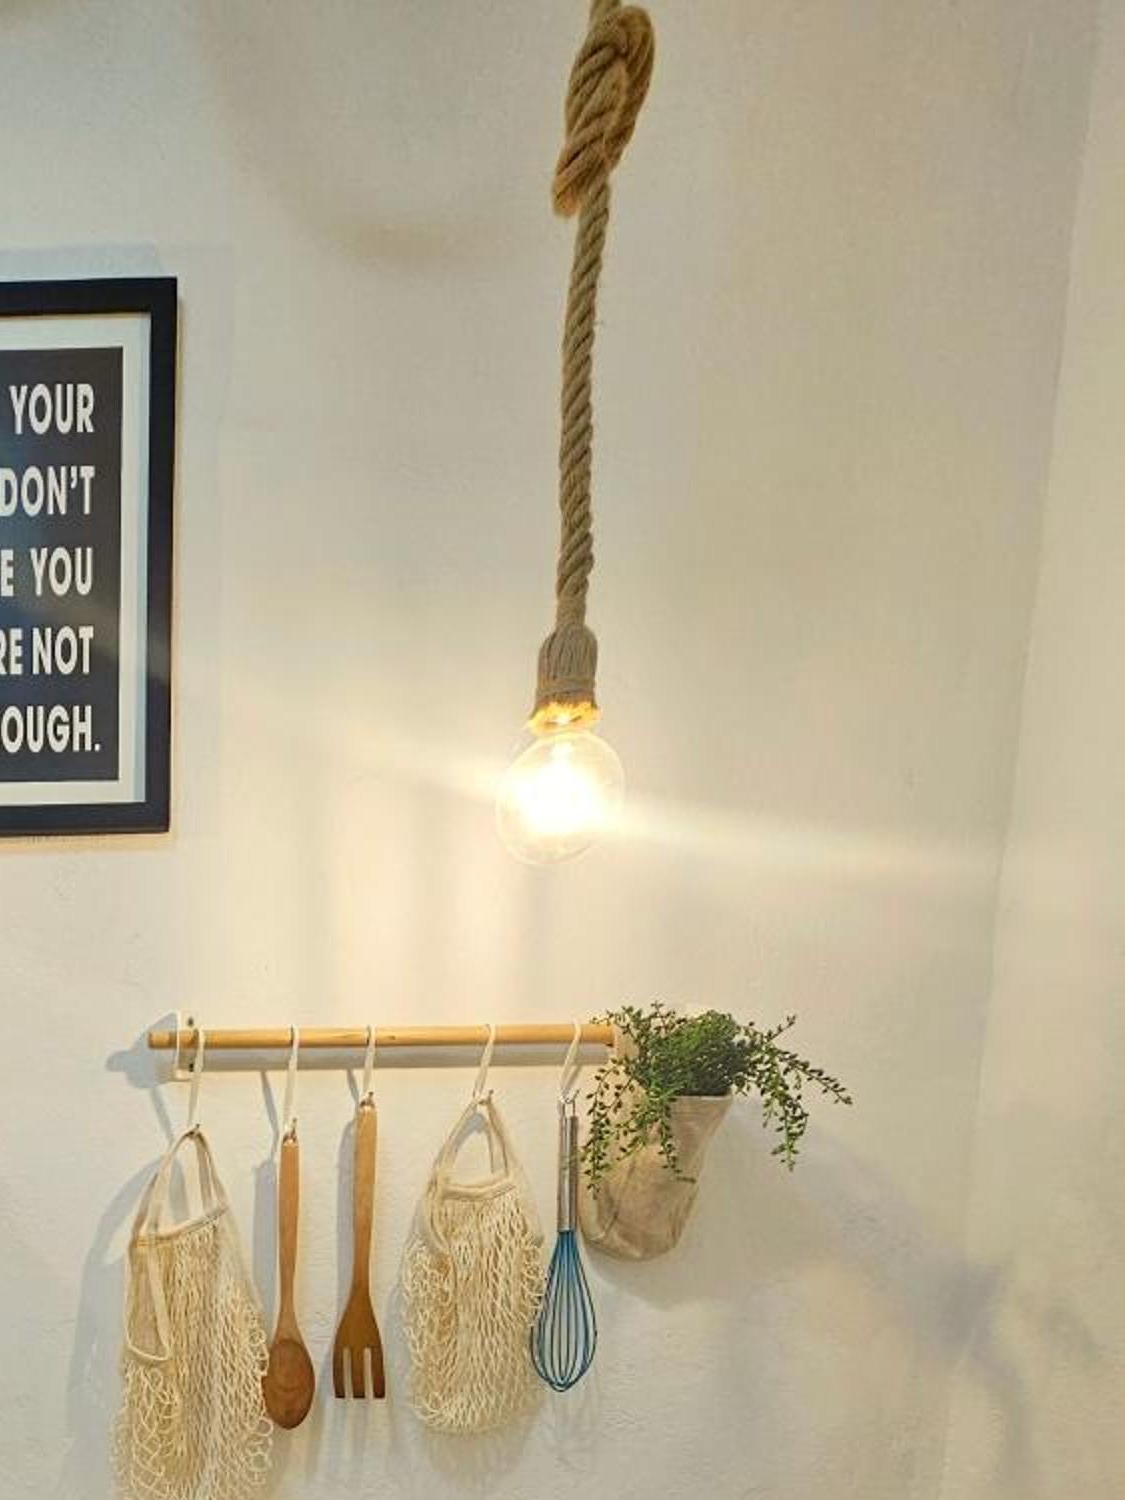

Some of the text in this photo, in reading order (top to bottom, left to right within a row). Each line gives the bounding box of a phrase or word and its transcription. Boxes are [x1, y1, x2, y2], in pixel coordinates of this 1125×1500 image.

[9, 383, 95, 435] YOUR
[30, 546, 94, 597] YOU
[32, 625, 95, 676] NOT
